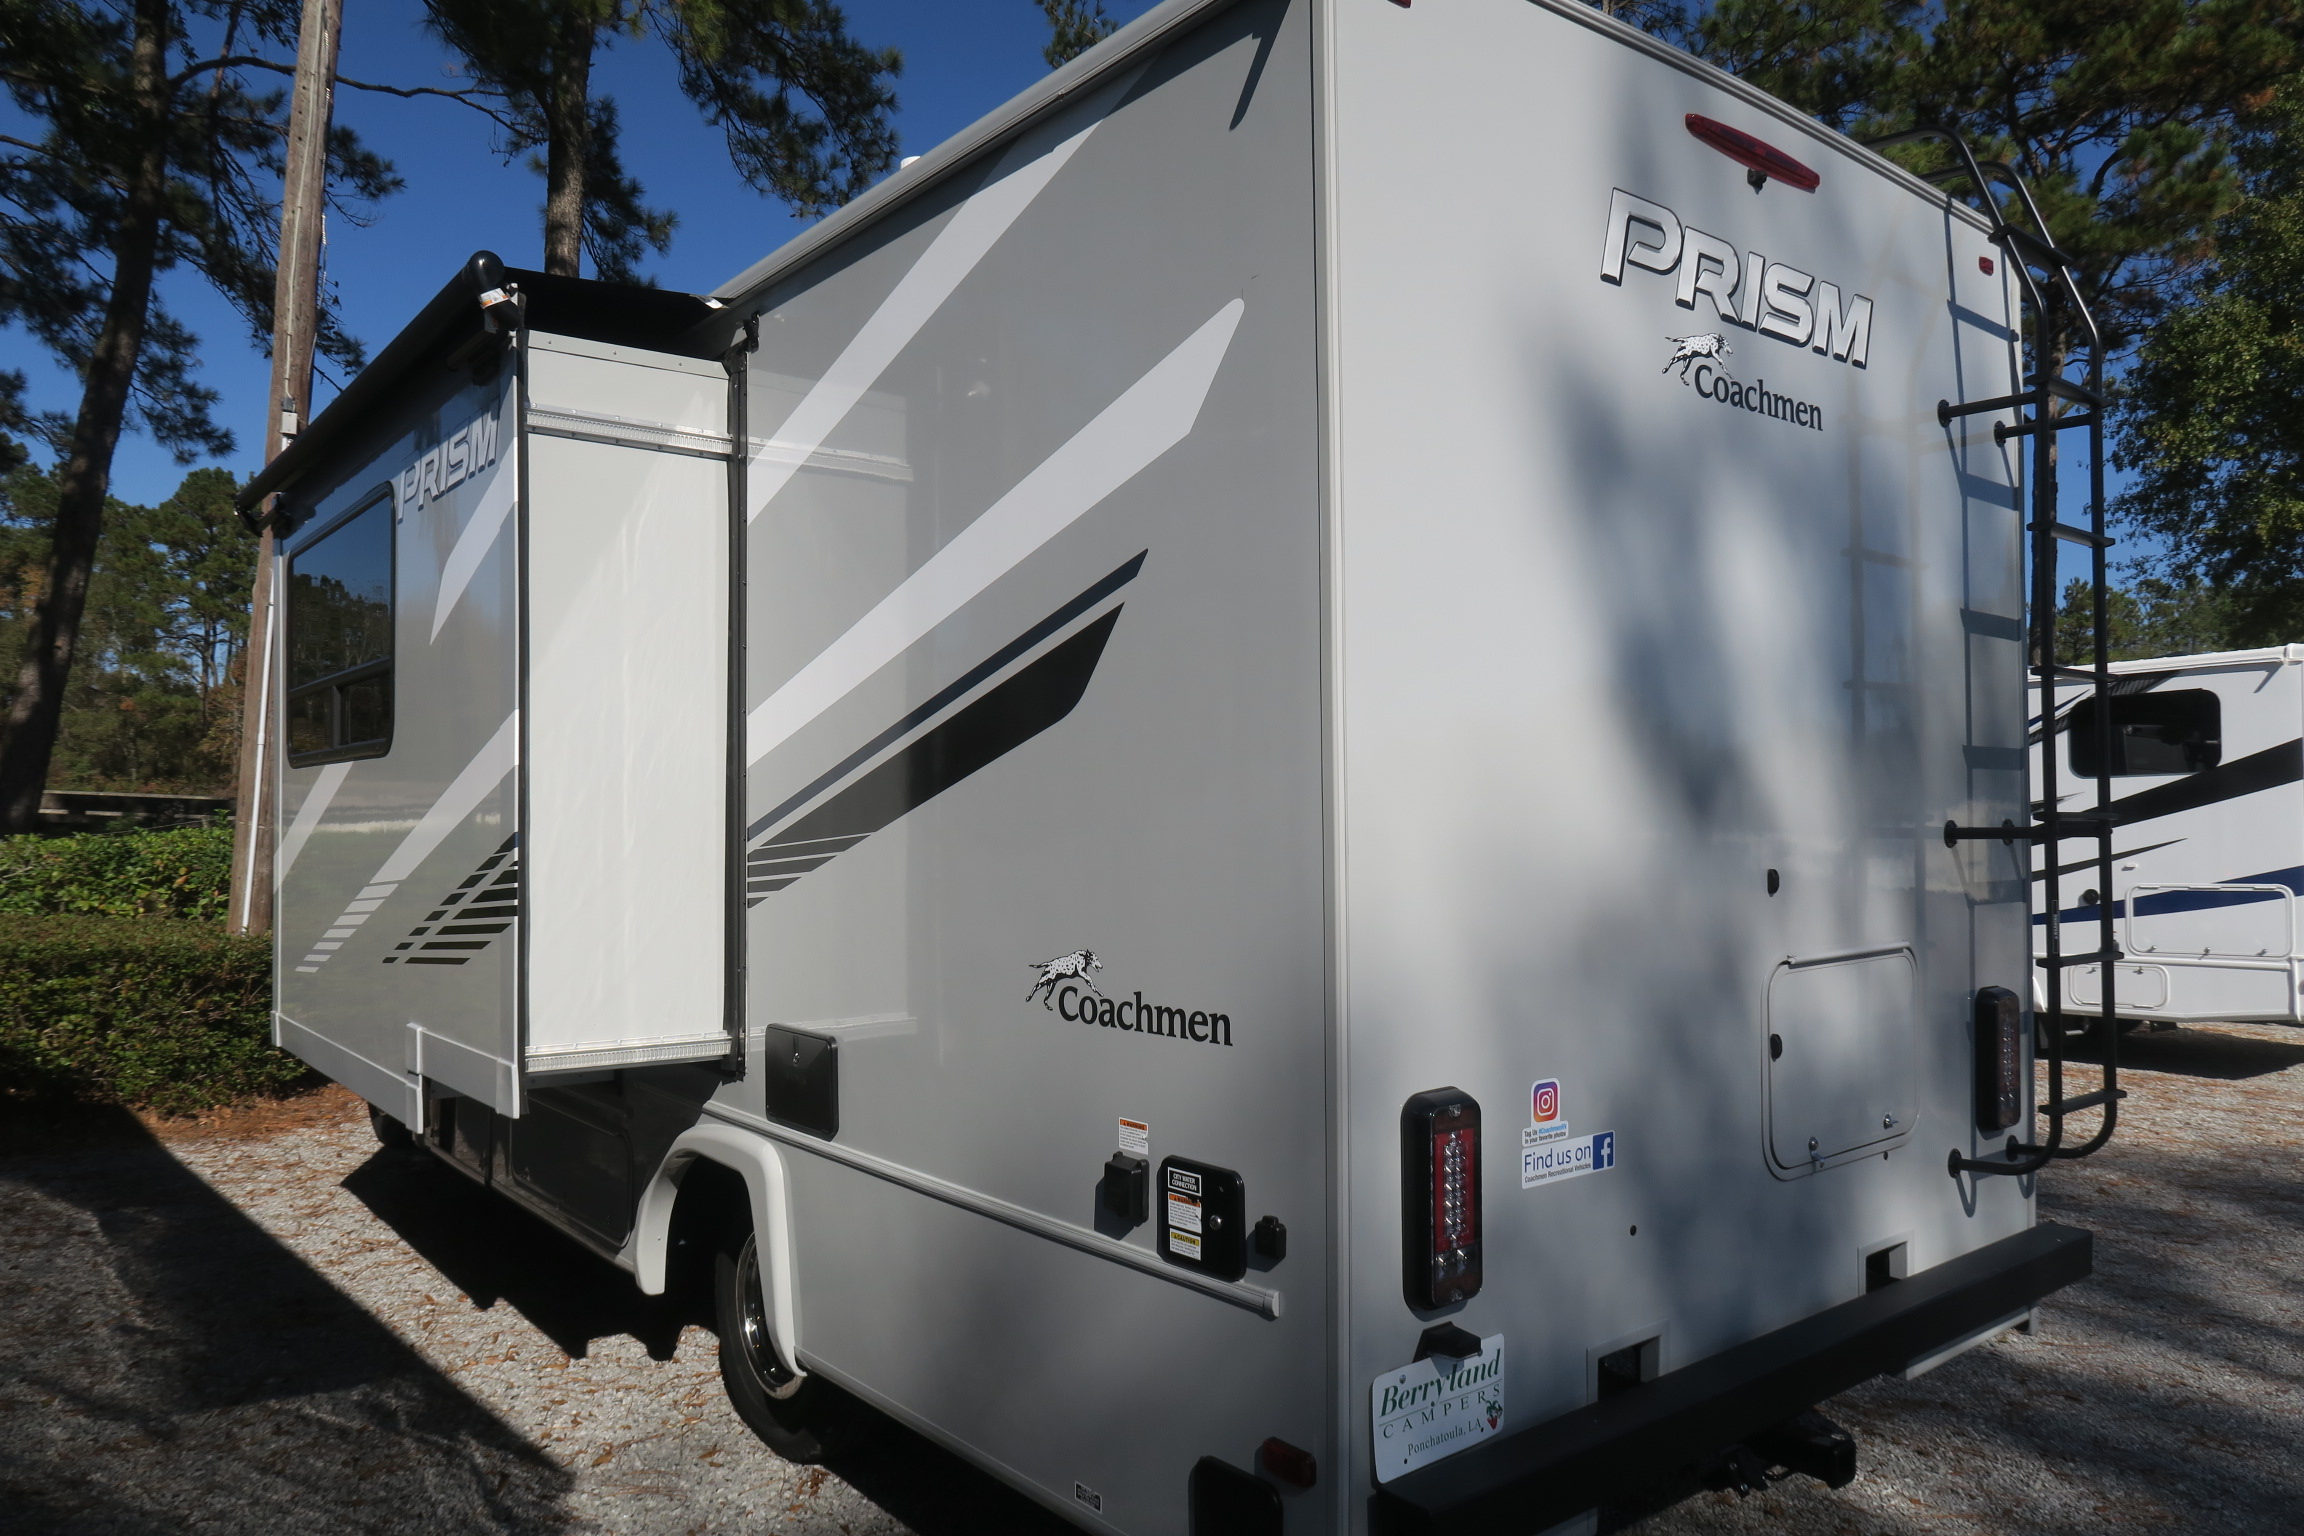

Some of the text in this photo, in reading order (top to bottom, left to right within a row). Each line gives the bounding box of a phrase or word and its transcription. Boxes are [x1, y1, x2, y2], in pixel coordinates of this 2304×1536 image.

[1600, 187, 1873, 370] PRISM
[1694, 364, 1824, 432] Coachmen
[397, 397, 500, 525] PRISM
[1058, 985, 1233, 1047] Coachmen
[1524, 1148, 1553, 1173] Find
[1557, 1149, 1572, 1165] us
[1575, 1145, 1592, 1161] on
[1554, 1131, 1567, 1139] photos
[1172, 1179, 1197, 1191] CONNECTION
[1524, 1162, 1592, 1183] Coachmen Recreational Vehicles
[1380, 1348, 1501, 1417] Berryland
[1383, 1384, 1500, 1439] CAMPERS
[1407, 1418, 1482, 1456] Ponchatoula, LA
